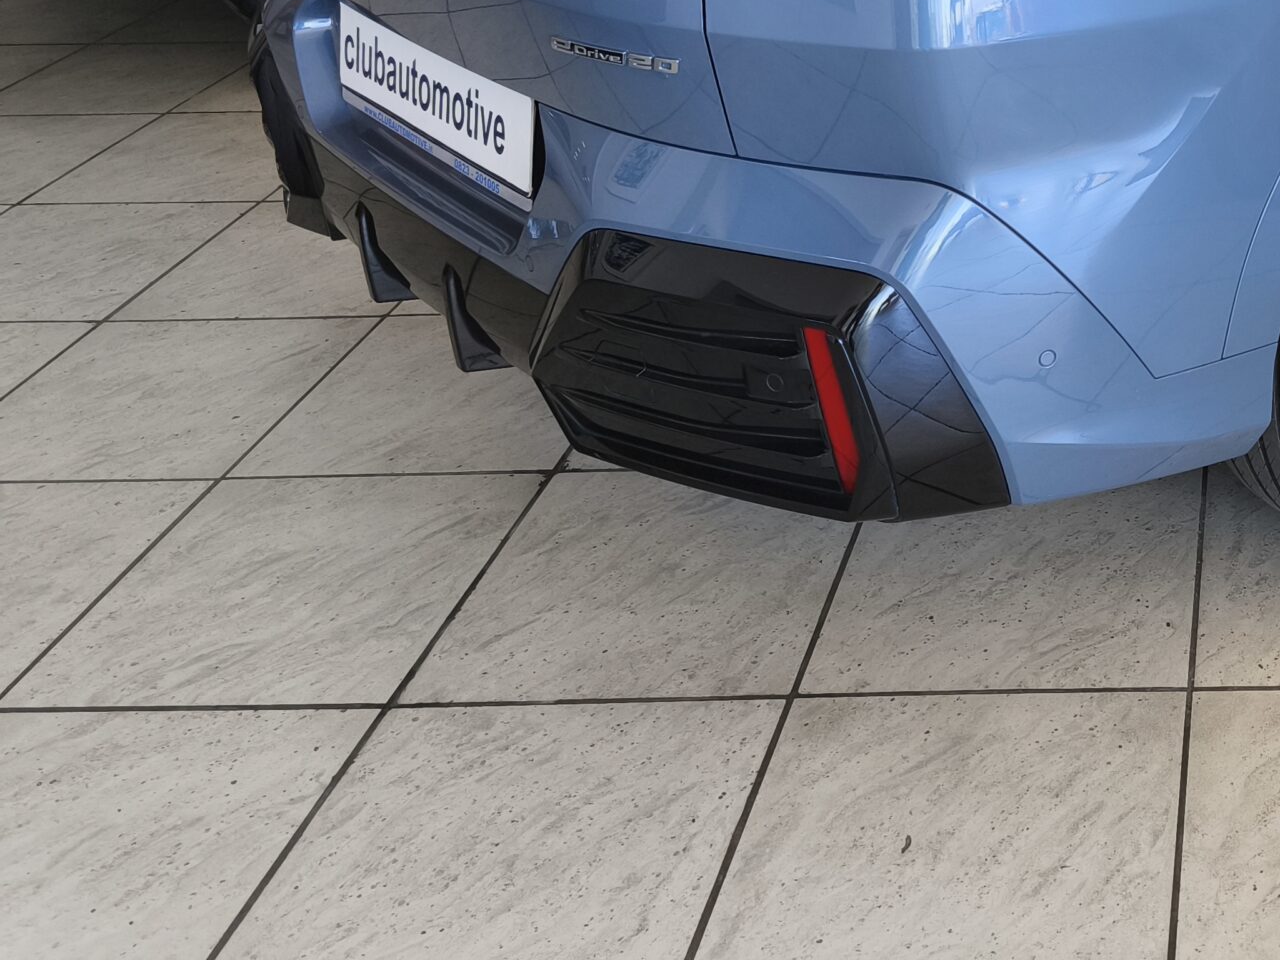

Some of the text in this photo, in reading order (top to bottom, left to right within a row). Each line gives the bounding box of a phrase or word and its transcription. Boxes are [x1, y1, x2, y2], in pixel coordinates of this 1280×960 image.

[344, 27, 506, 155] clubautomotive
[454, 159, 470, 177] 0823
[475, 171, 500, 194] 201005
